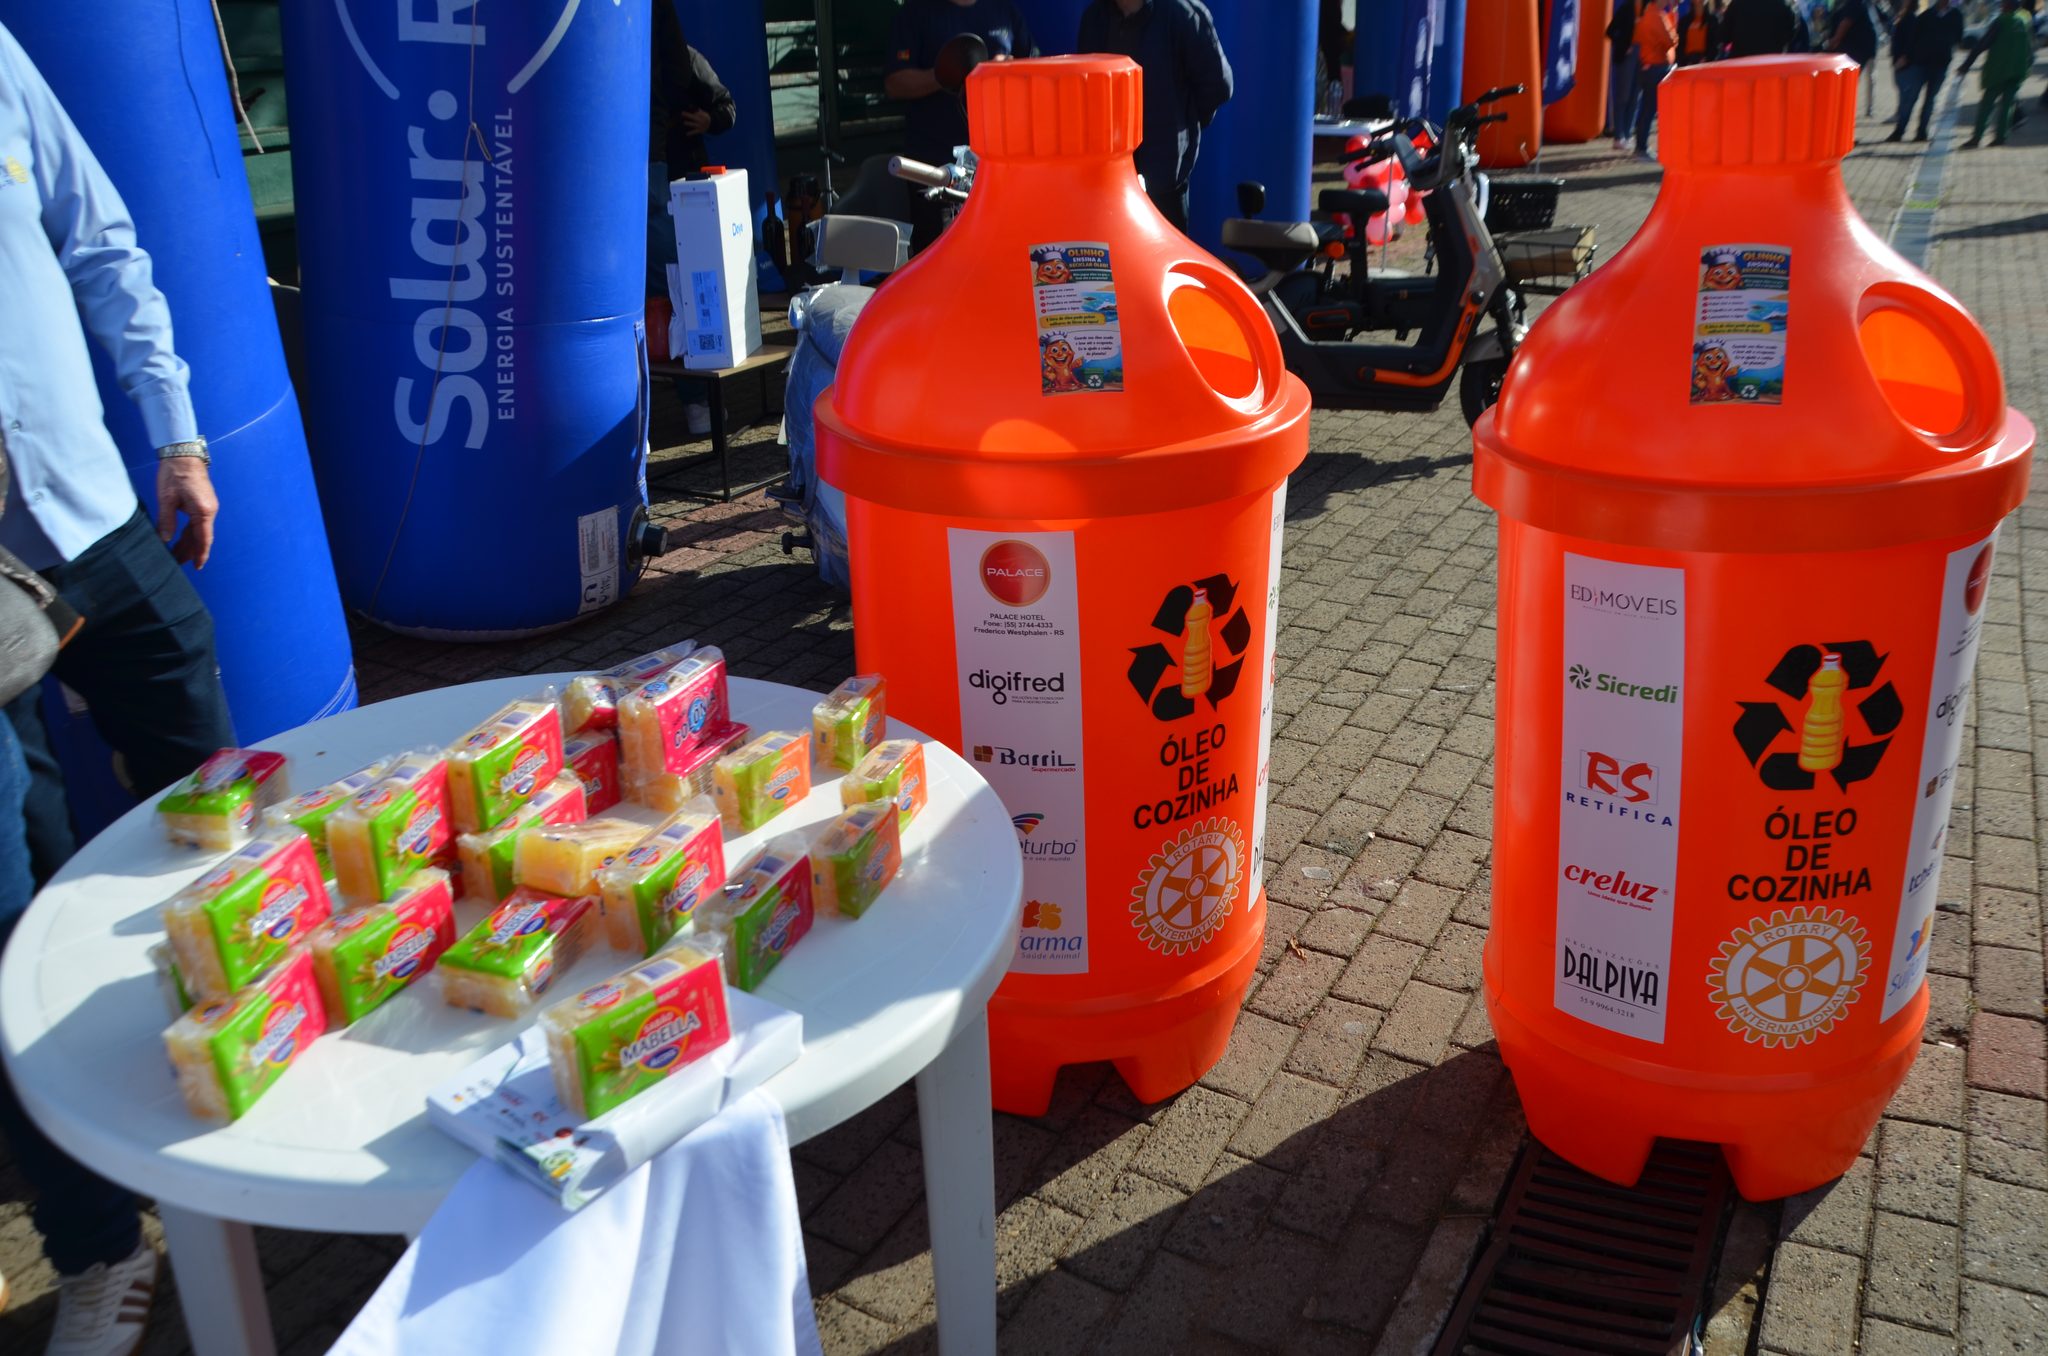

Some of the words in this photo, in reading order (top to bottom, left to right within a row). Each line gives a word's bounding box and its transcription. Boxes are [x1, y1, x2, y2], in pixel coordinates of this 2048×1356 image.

[491, 107, 514, 296] SUSTENTÁVEL
[1067, 248, 1105, 258] OLINHO
[496, 307, 516, 420] ENERGIA
[986, 567, 1044, 577] PALACE
[973, 626, 1006, 636] Frederico
[1007, 627, 1048, 637] Westphalen
[983, 620, 1003, 628] Fone:
[1018, 621, 1053, 629] 3744-4333
[968, 668, 1065, 706] digifred
[1595, 673, 1679, 704] Sicredi
[1160, 723, 1226, 766] ÓLEO
[1178, 758, 1209, 791] DE
[1586, 751, 1653, 803] RS
[1133, 772, 1239, 829] COZINHA
[1566, 791, 1673, 827] RETÍFICA
[1764, 805, 1858, 840] ÓLEO
[1172, 833, 1220, 862] ROTARY
[1785, 843, 1832, 872] DE
[1563, 864, 1660, 904] creluz
[1727, 867, 1872, 903] COZINHA
[1154, 885, 1234, 941] INTERNATIONAL
[1762, 924, 1832, 943] ROTARY
[1022, 951, 1046, 959] Saúde
[1049, 952, 1080, 960] Animal
[1563, 944, 1659, 1007] DALPIVA
[1736, 987, 1848, 1034] INTERNATIONAL
[619, 1010, 702, 1068] MABELLA
